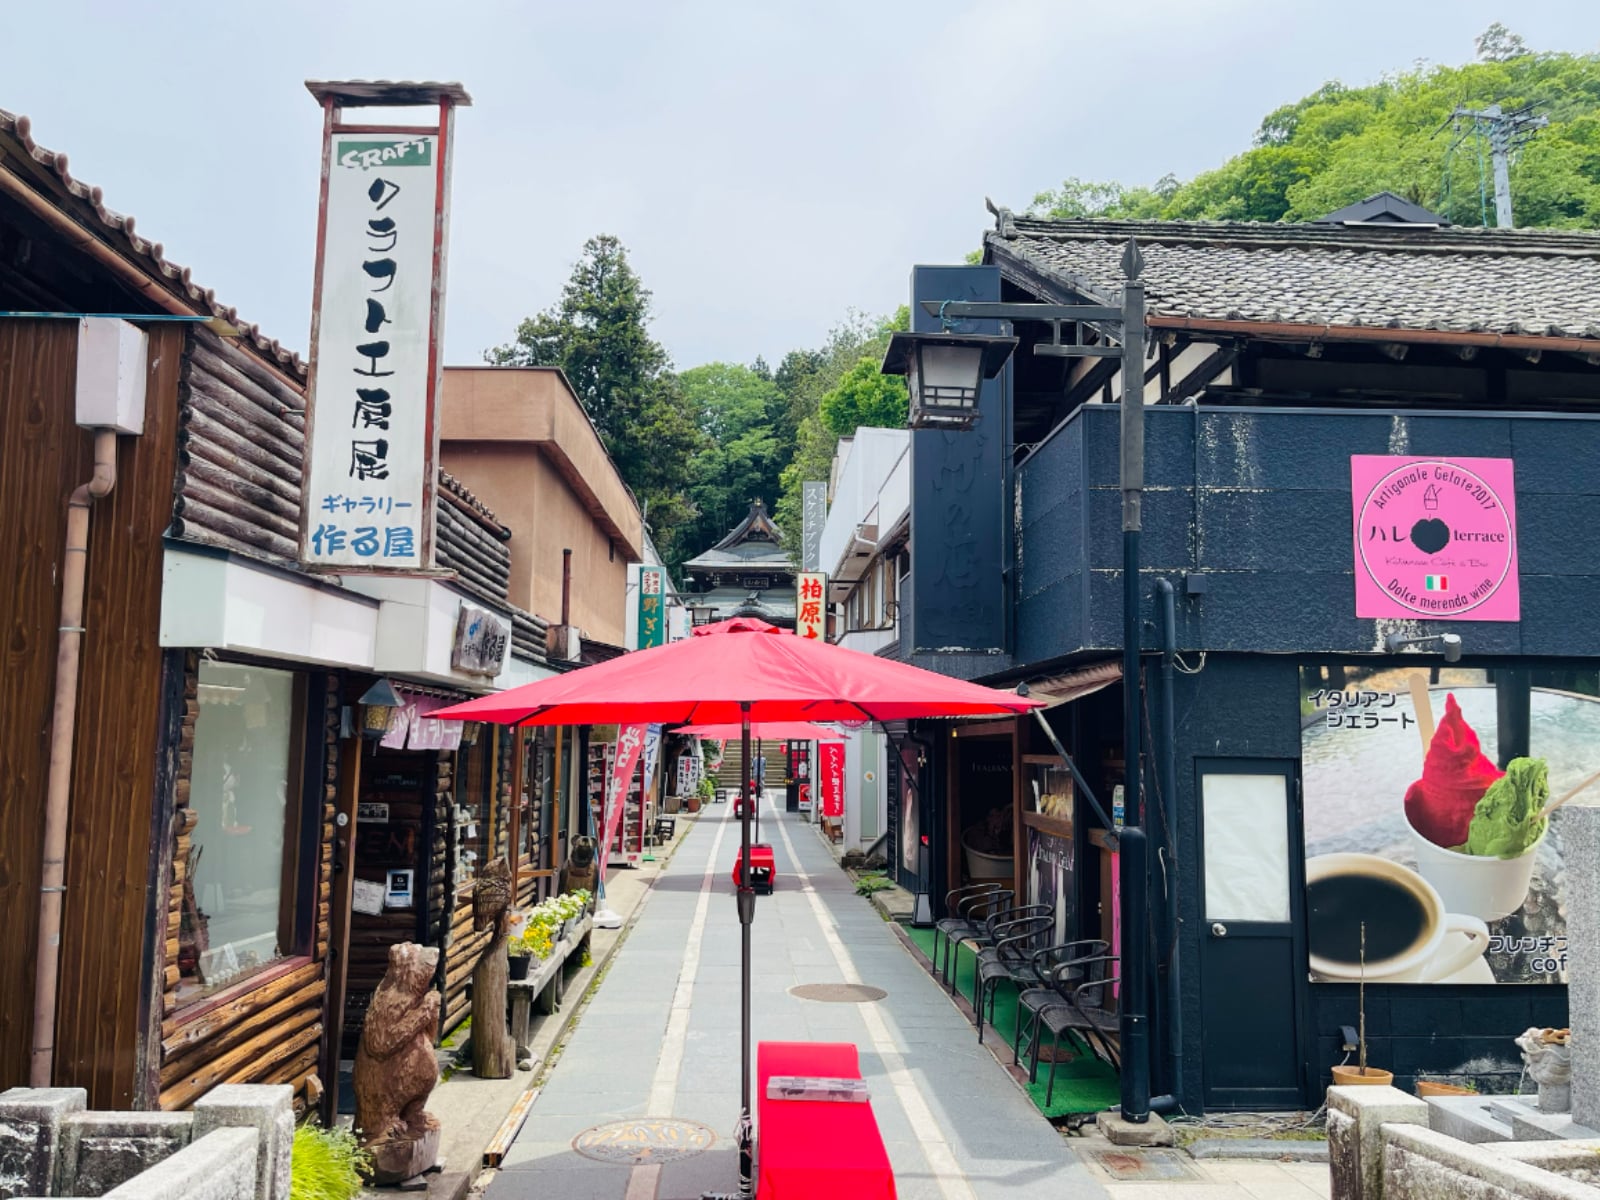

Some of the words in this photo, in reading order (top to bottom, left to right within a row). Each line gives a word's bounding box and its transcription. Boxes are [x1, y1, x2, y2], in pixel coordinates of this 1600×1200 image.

[341, 138, 429, 170] CRAFT
[321, 495, 412, 515] ギャラリー
[311, 524, 415, 558] 作る屋
[1368, 525, 1406, 543] ハレ
[1453, 529, 1505, 543] terrace
[1387, 577, 1417, 605] Dolce
[1420, 593, 1469, 610] merenda
[1469, 578, 1494, 600] wine
[1308, 688, 1397, 708] イタリアン
[1327, 709, 1415, 729] ジェラート
[645, 737, 657, 773] アイス
